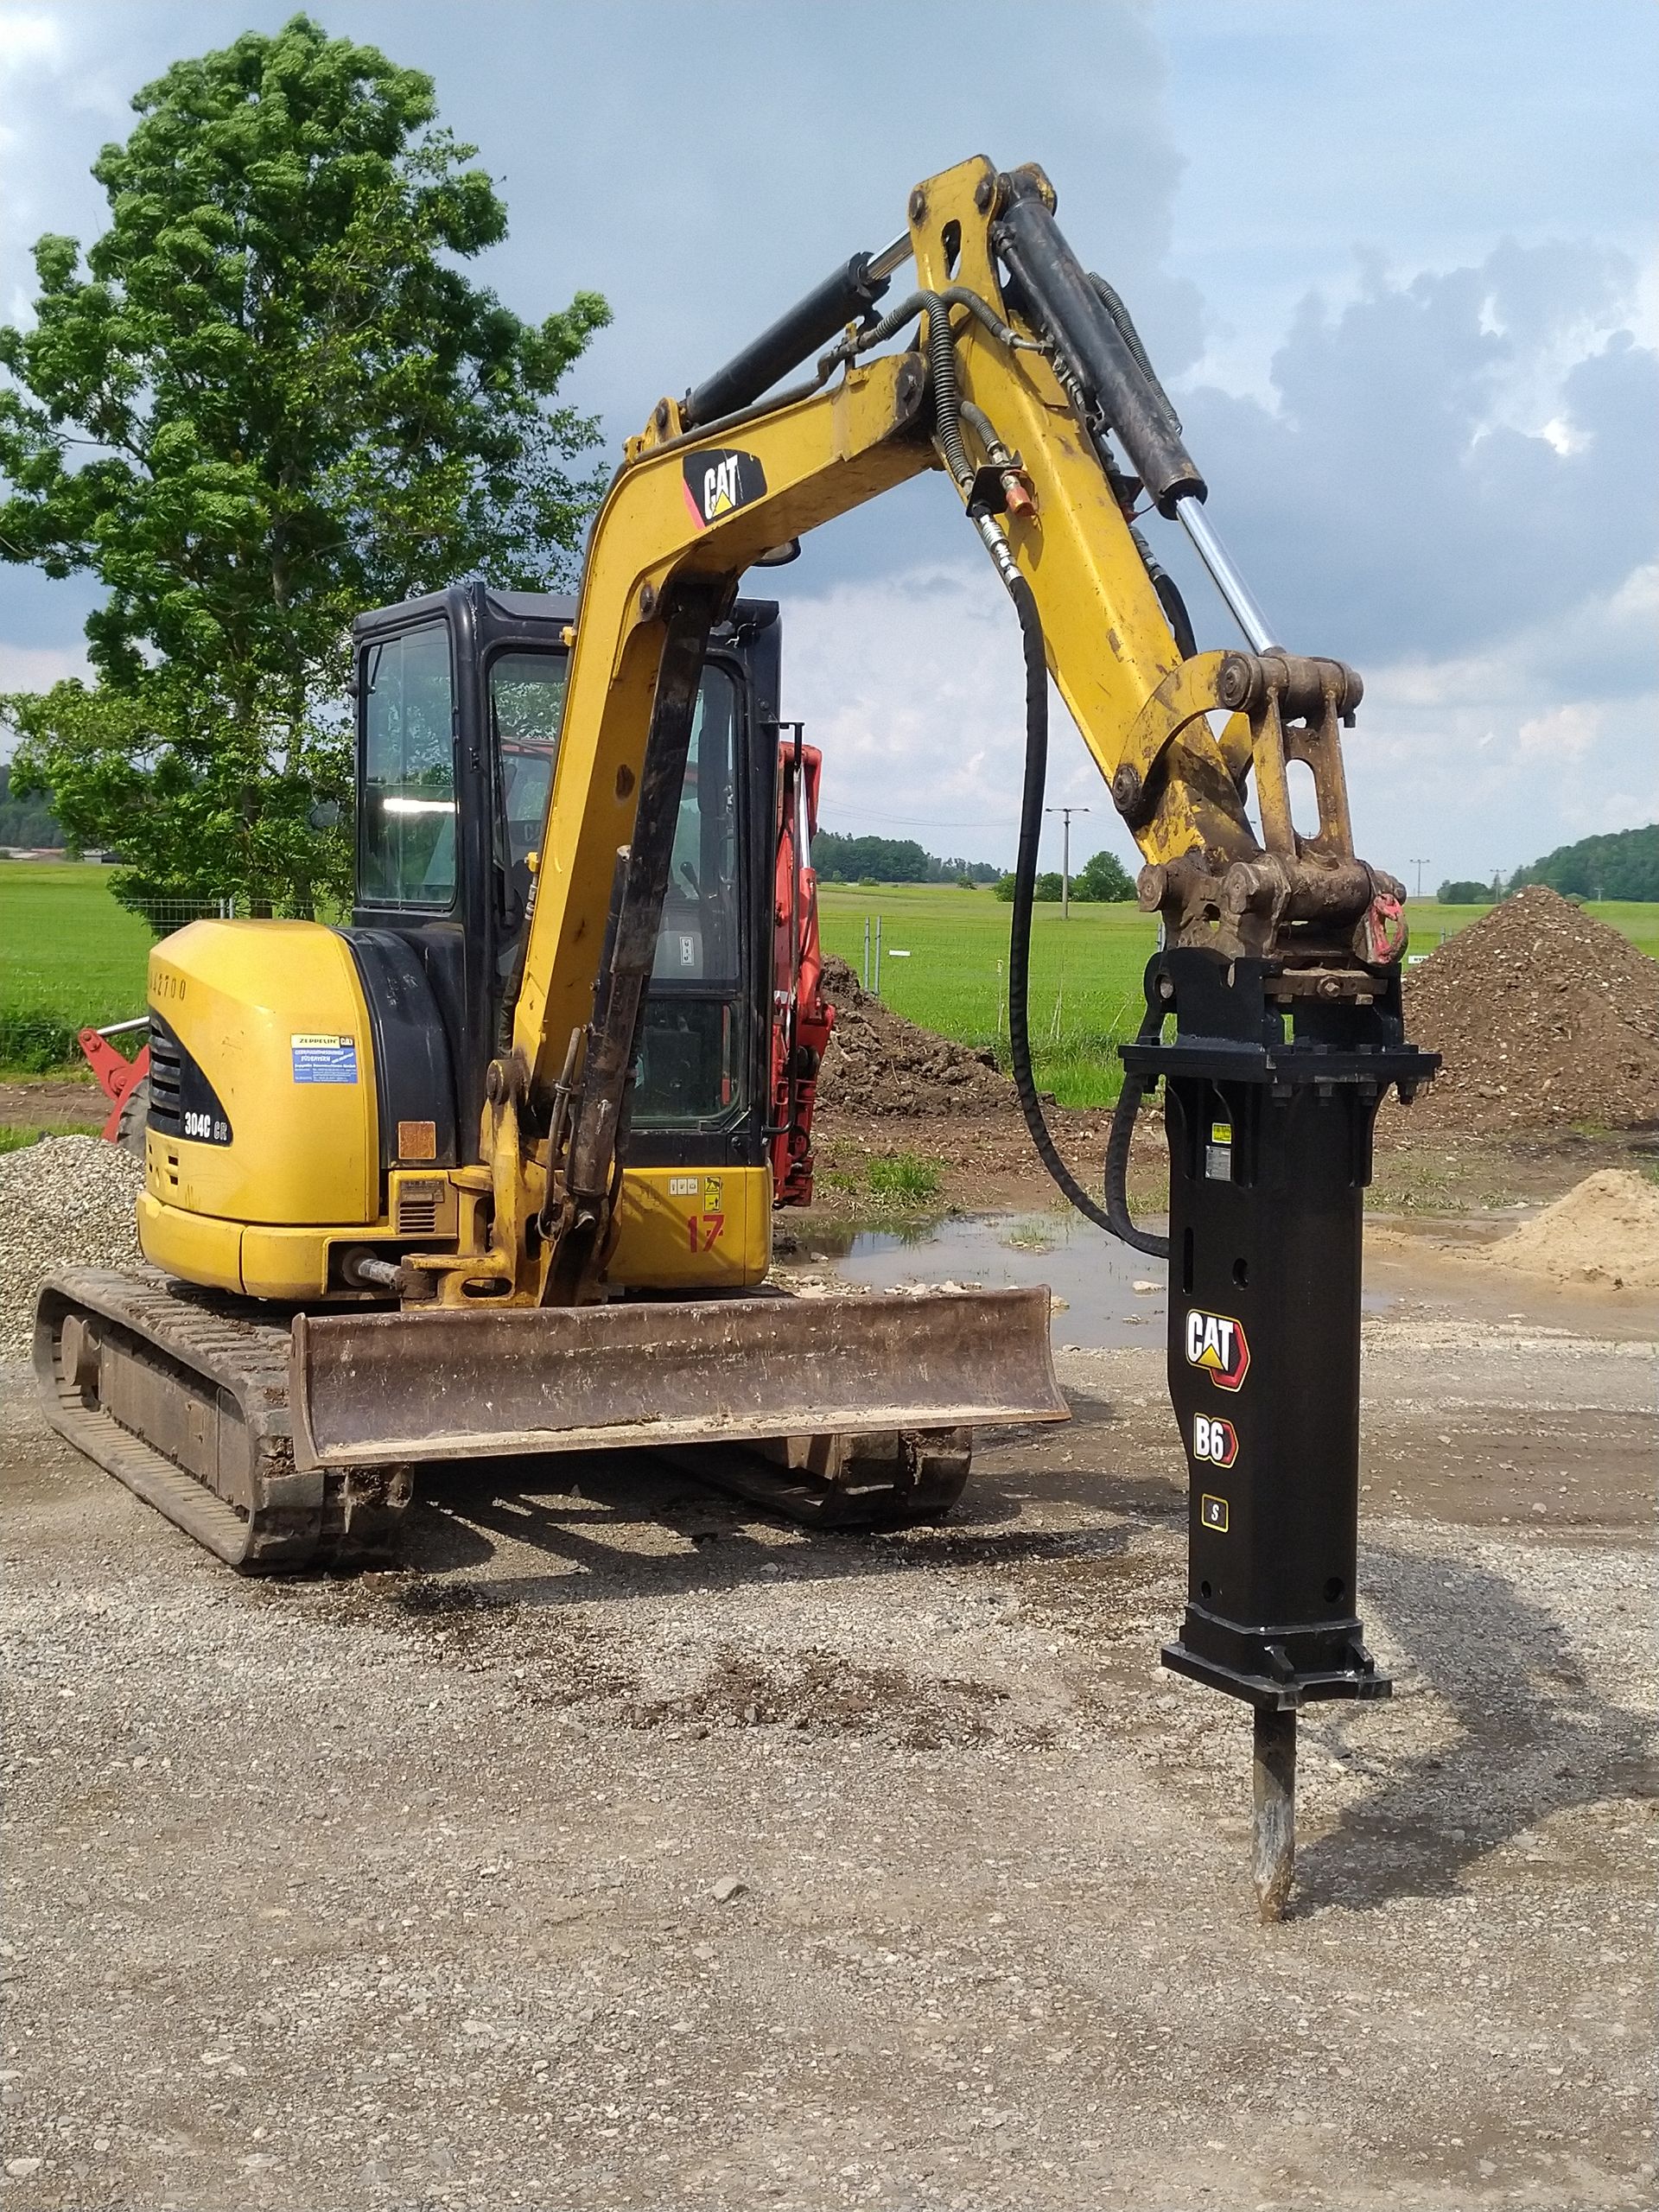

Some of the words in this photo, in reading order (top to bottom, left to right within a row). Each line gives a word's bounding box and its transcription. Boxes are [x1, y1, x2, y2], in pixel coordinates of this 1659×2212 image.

[703, 454, 738, 520] CAT
[184, 1111, 211, 1138] 304C
[213, 1121, 227, 1141] CR
[688, 1214, 725, 1253] 17
[1187, 1312, 1234, 1372] CAT
[1196, 1416, 1224, 1461] B6
[1211, 1503, 1220, 1522] S
